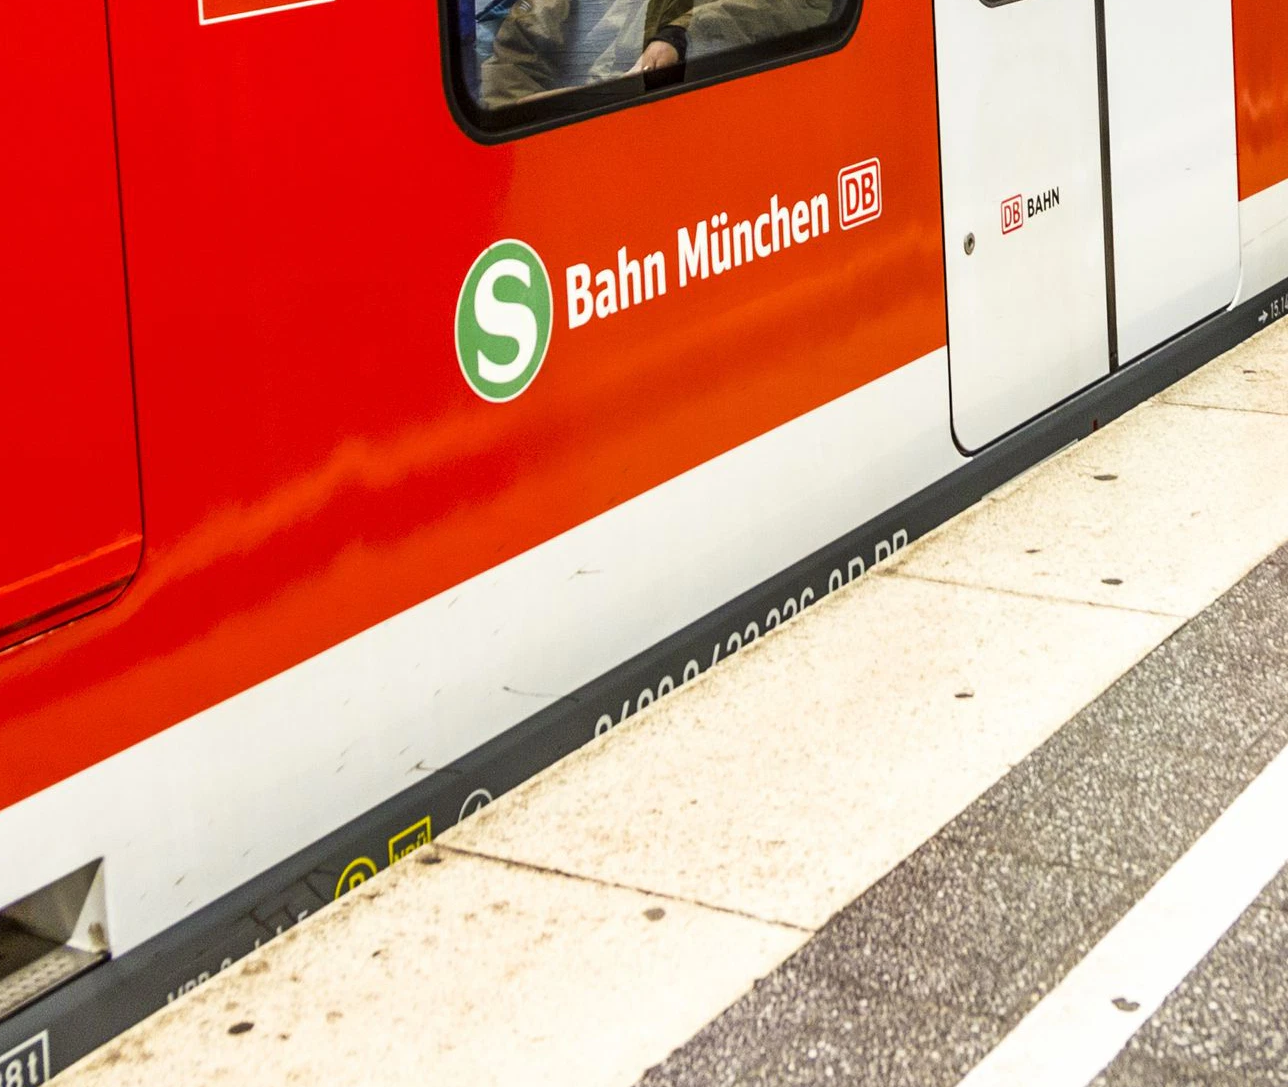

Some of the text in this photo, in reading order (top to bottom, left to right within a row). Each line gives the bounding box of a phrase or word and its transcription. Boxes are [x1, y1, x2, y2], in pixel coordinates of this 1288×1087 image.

[843, 166, 878, 222] DB
[1026, 186, 1061, 219] BAHN
[473, 189, 833, 385] S Bahn München
